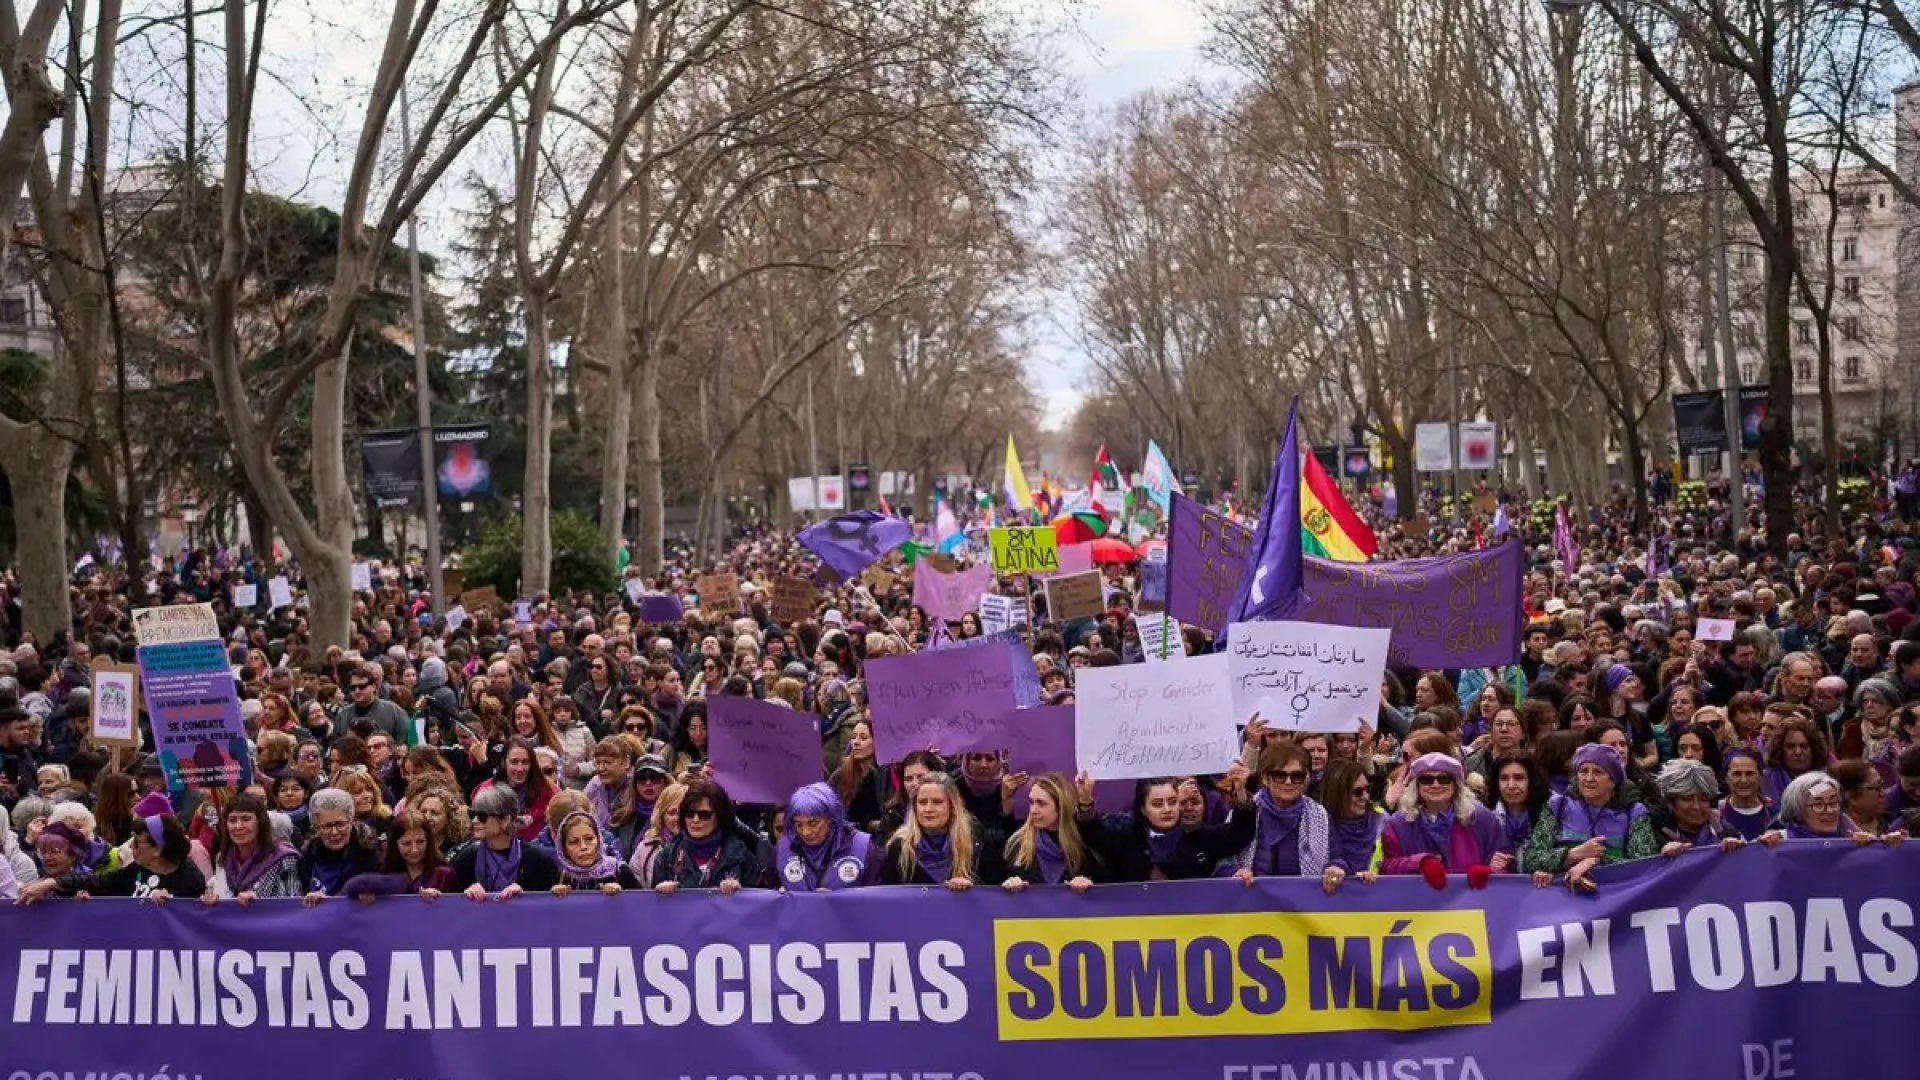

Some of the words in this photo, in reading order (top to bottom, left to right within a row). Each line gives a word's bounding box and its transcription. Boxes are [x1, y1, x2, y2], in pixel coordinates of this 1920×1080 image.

[435, 430, 488, 441] LUZMADRID
[1008, 528, 1036, 548] 8M
[993, 546, 1058, 570] LATINA
[1110, 679, 1148, 713] Stop
[1162, 676, 1215, 700] Gender
[168, 721, 179, 732] SE
[12, 949, 369, 1030] FEMINISTAS
[385, 940, 969, 1030] ANTIFASCISTAS
[1005, 933, 1287, 1021] SOMOS
[1307, 920, 1481, 1012] MÁS
[1517, 918, 1616, 1000] EN
[1630, 897, 1919, 993] TODAS
[1742, 1038, 1796, 1080] DE
